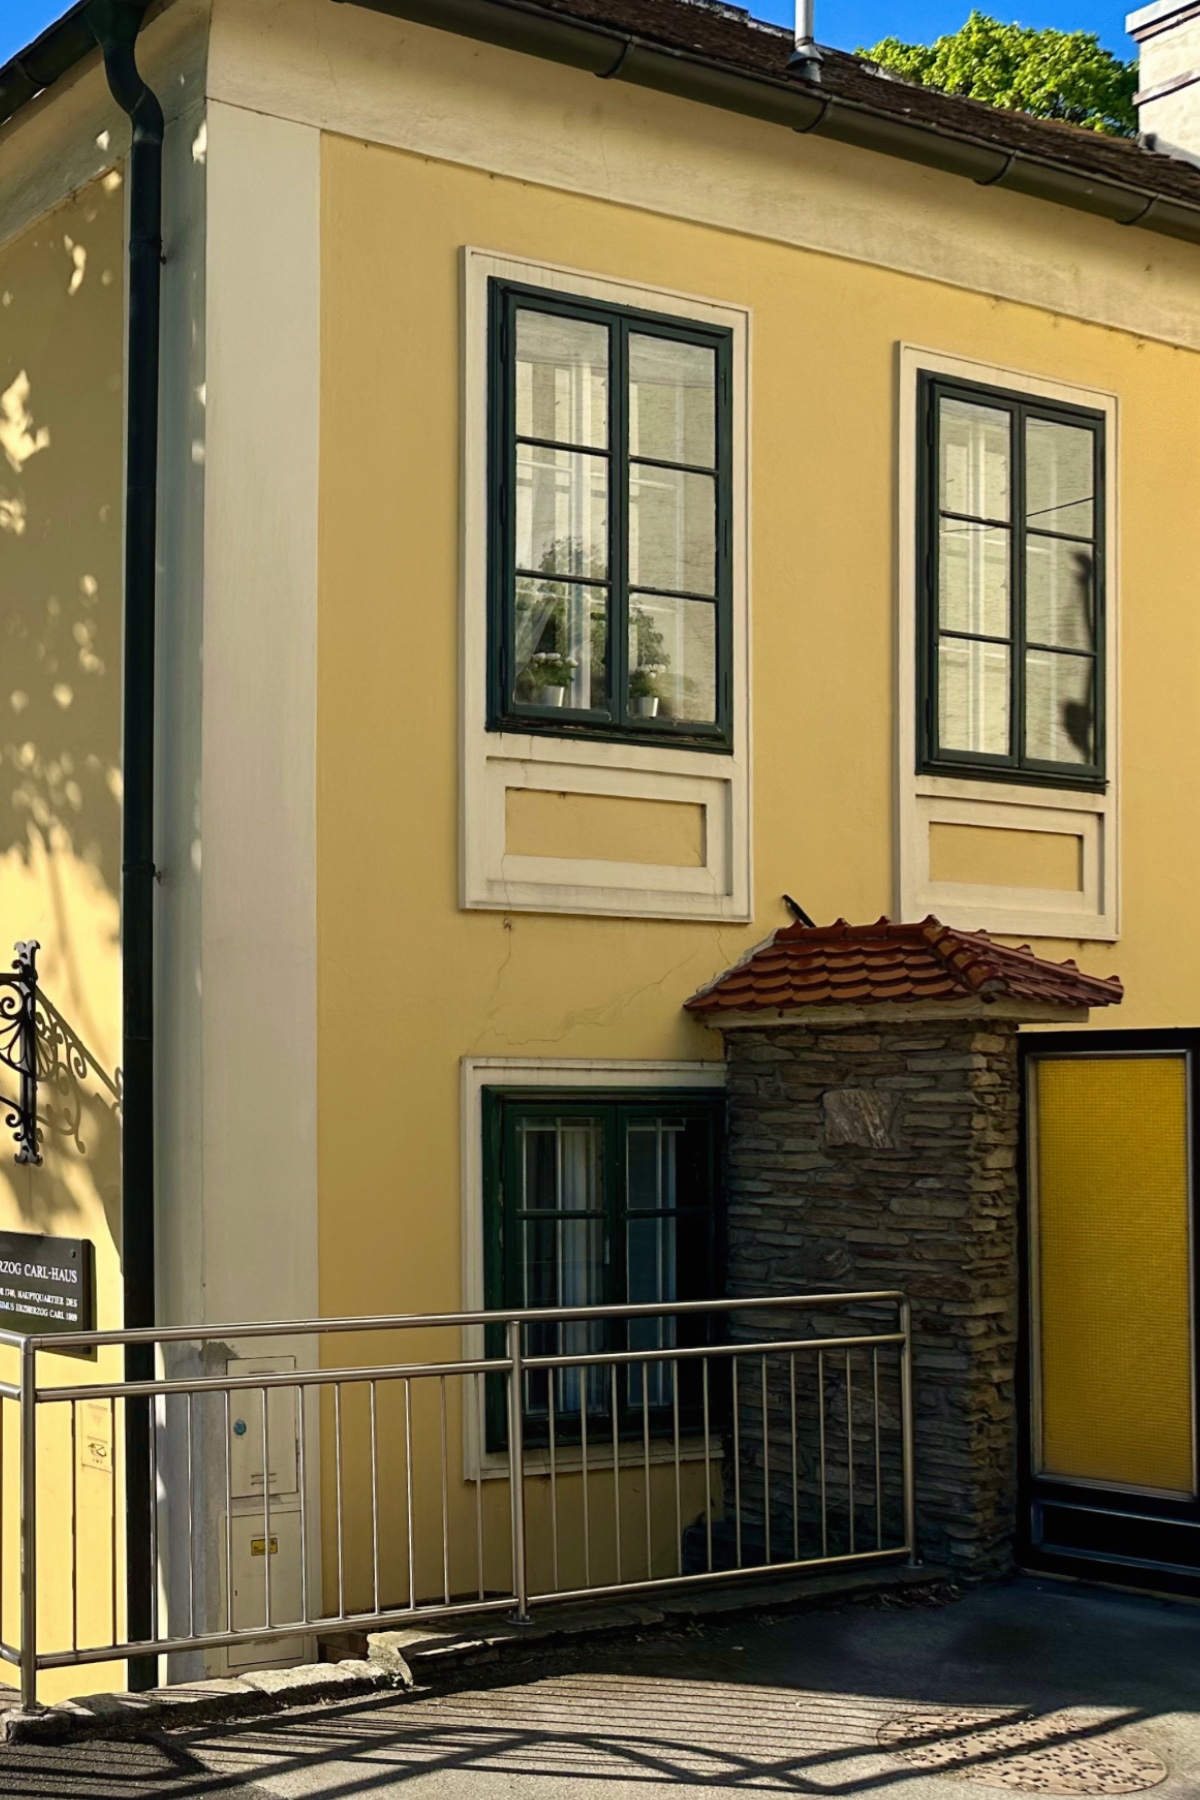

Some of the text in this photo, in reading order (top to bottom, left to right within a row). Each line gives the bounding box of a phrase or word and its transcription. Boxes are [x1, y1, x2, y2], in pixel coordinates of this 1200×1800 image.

[24, 1264, 77, 1283] CARL-HAUS
[17, 1290, 64, 1304] HAUPTQUARTIER
[66, 1297, 78, 1307] DES
[15, 1303, 48, 1317] ERZHERZOG
[49, 1309, 65, 1319] CARL
